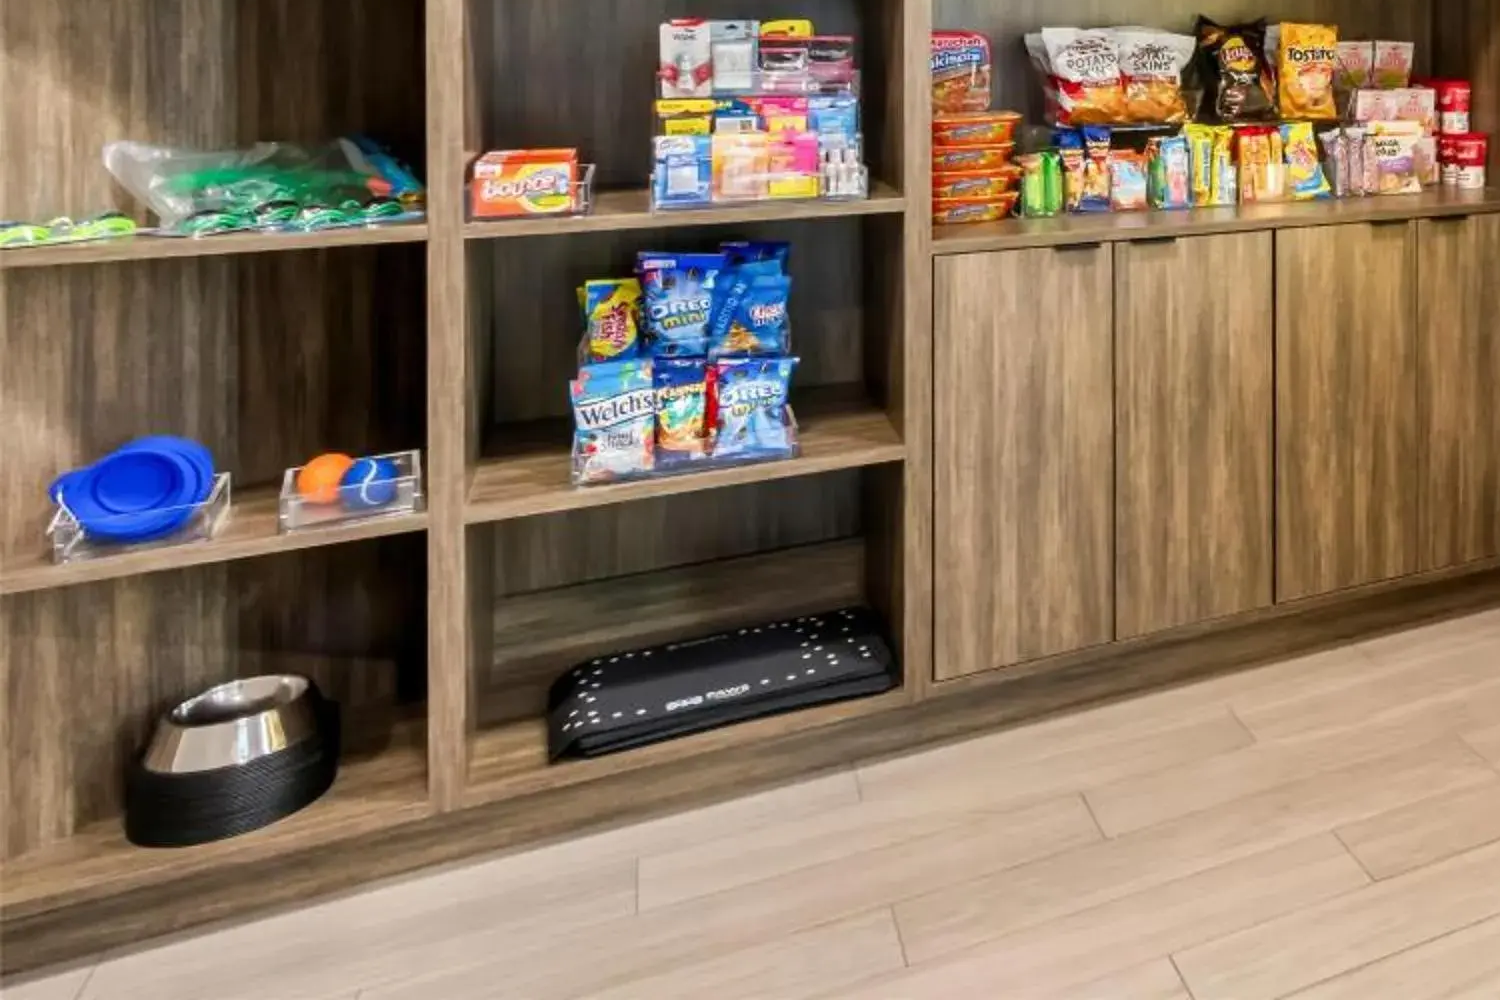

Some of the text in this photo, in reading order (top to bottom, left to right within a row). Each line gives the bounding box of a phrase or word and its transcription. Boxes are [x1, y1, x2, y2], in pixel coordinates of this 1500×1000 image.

[1133, 60, 1172, 71] SKINS
[481, 175, 557, 202] bounce
[650, 300, 711, 319] OREO
[581, 388, 657, 427] Welch's
